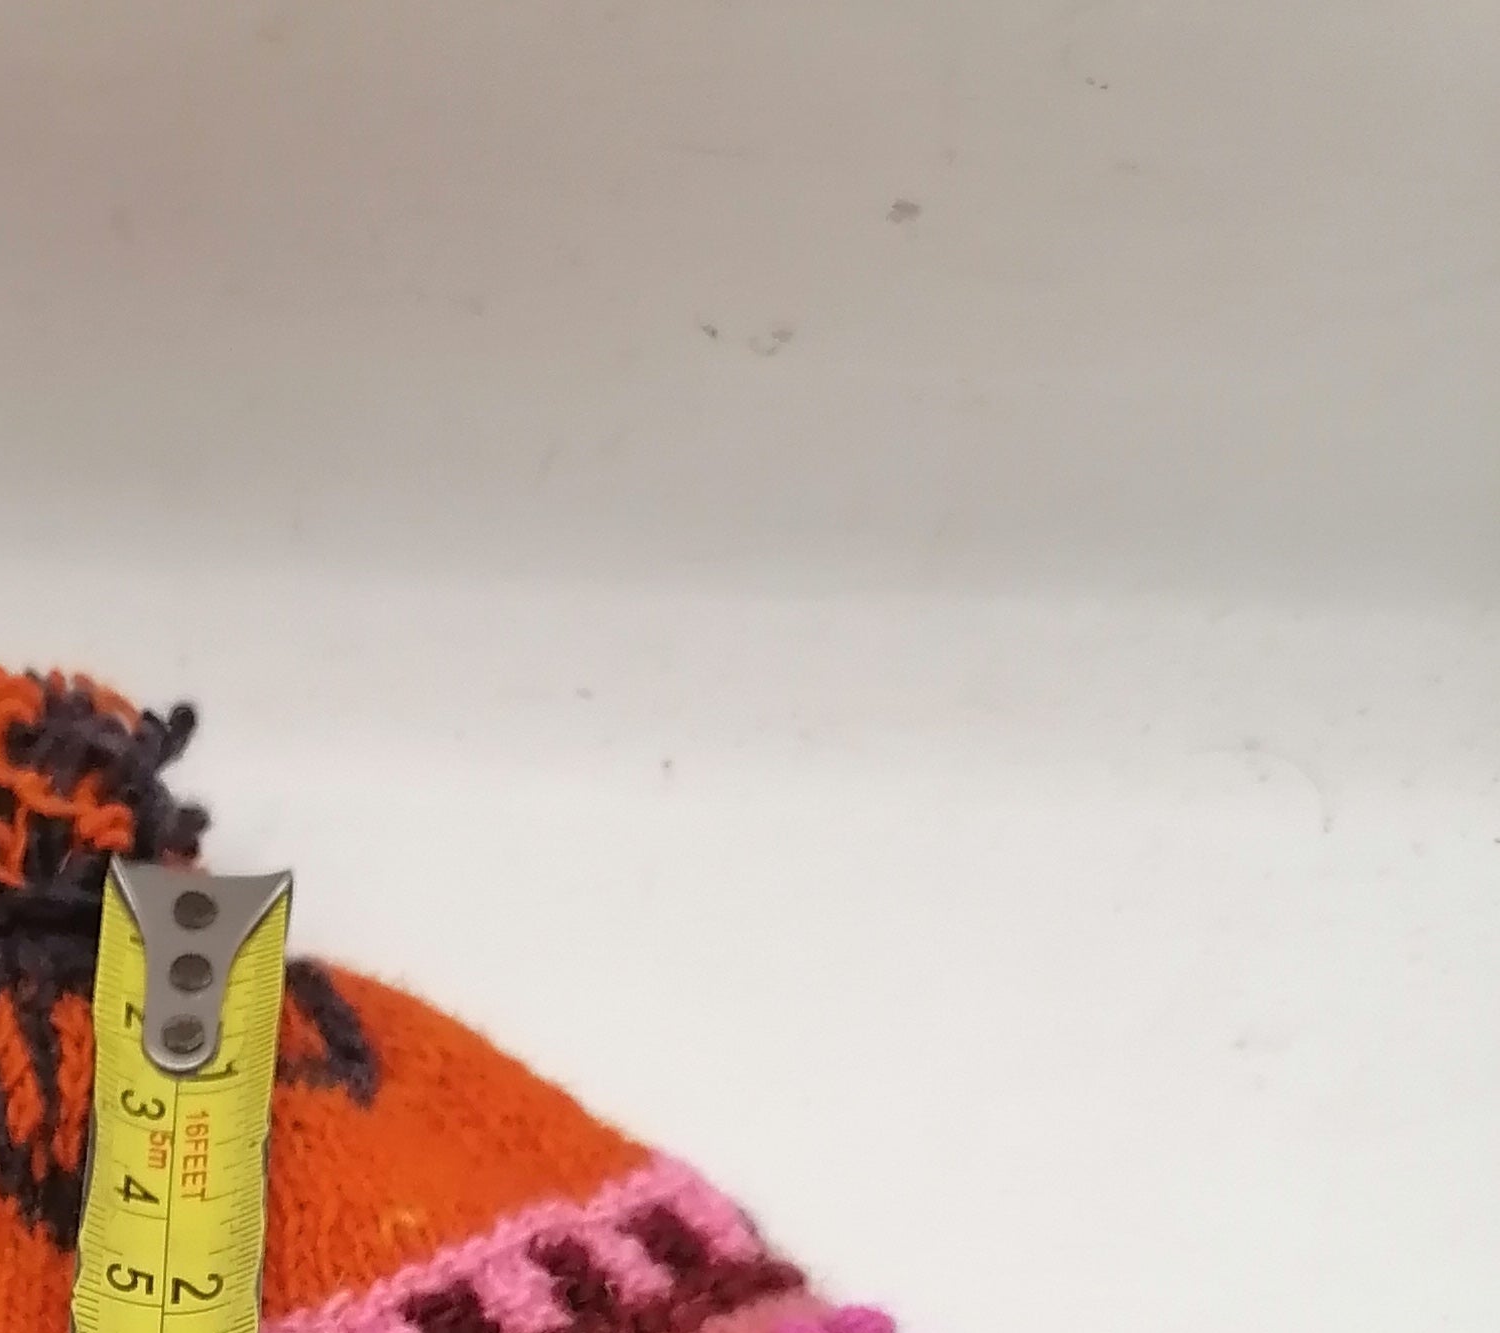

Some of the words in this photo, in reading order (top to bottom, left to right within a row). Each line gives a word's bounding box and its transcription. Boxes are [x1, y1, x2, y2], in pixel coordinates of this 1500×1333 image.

[120, 1089, 167, 1120] 3
[147, 1130, 174, 1170] 5m
[180, 1109, 211, 1202] 16FEET
[121, 1174, 160, 1206] 4
[106, 1263, 155, 1296] 5
[171, 1273, 224, 1305] 2
